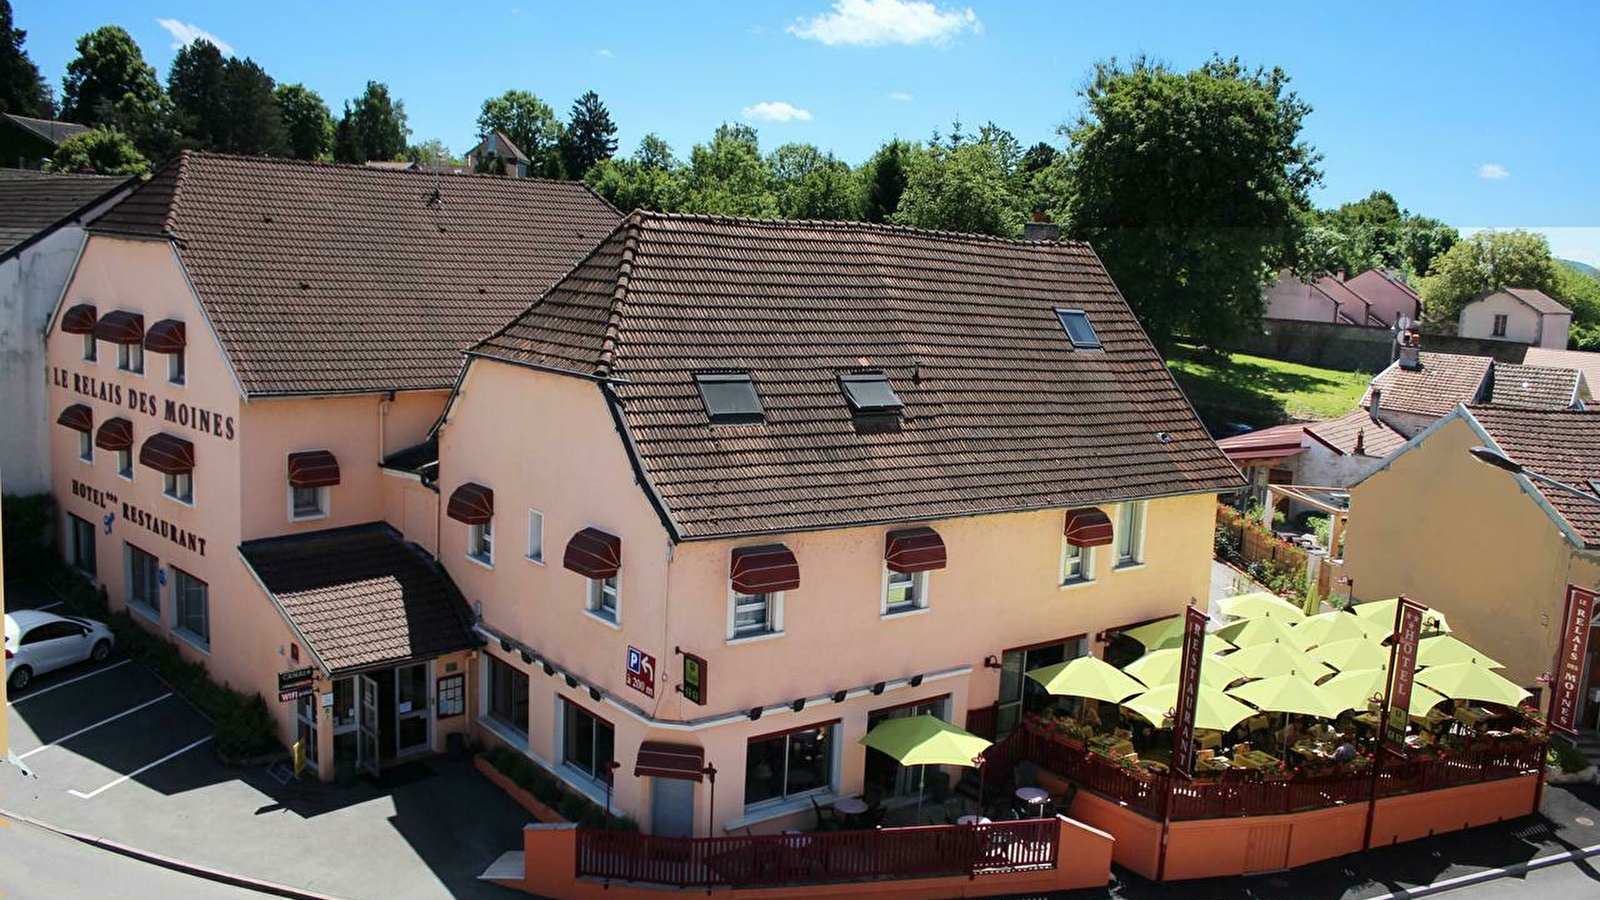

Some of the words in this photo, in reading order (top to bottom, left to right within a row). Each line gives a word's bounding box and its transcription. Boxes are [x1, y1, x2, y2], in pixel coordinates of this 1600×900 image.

[54, 367, 68, 388] LE
[74, 373, 122, 406] RELAIS
[128, 388, 157, 416] DES
[164, 399, 235, 440] MOINES
[72, 479, 107, 509] HOTEL
[122, 502, 207, 556] RESTAURANT
[630, 652, 638, 668] P
[1398, 629, 1415, 696] HOTEL
[1570, 608, 1586, 661] RELAIS
[632, 677, 645, 692] 200
[1179, 623, 1201, 766] RESTAURANT
[1560, 672, 1577, 725] MOINES
